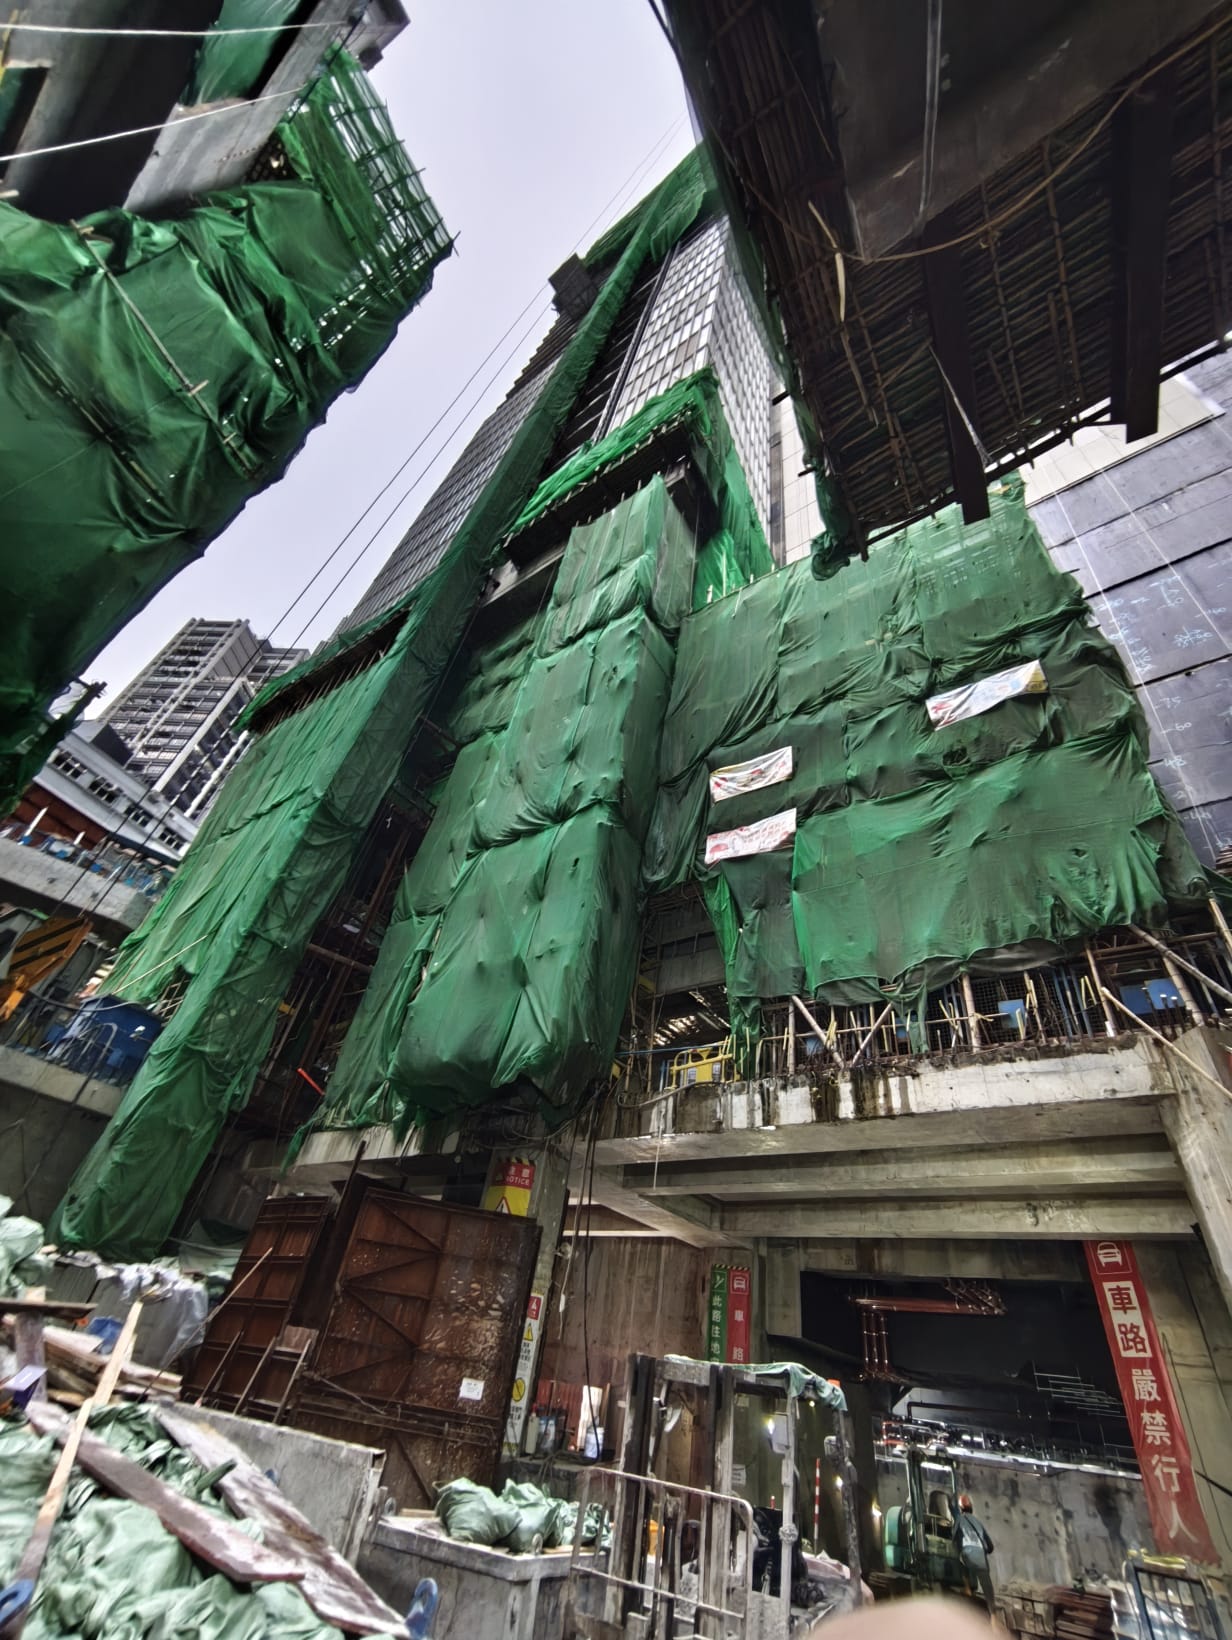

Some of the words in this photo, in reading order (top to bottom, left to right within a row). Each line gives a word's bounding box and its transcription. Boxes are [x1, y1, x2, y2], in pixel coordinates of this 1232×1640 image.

[1107, 1284, 1200, 1544] 車路嚴禁行人
